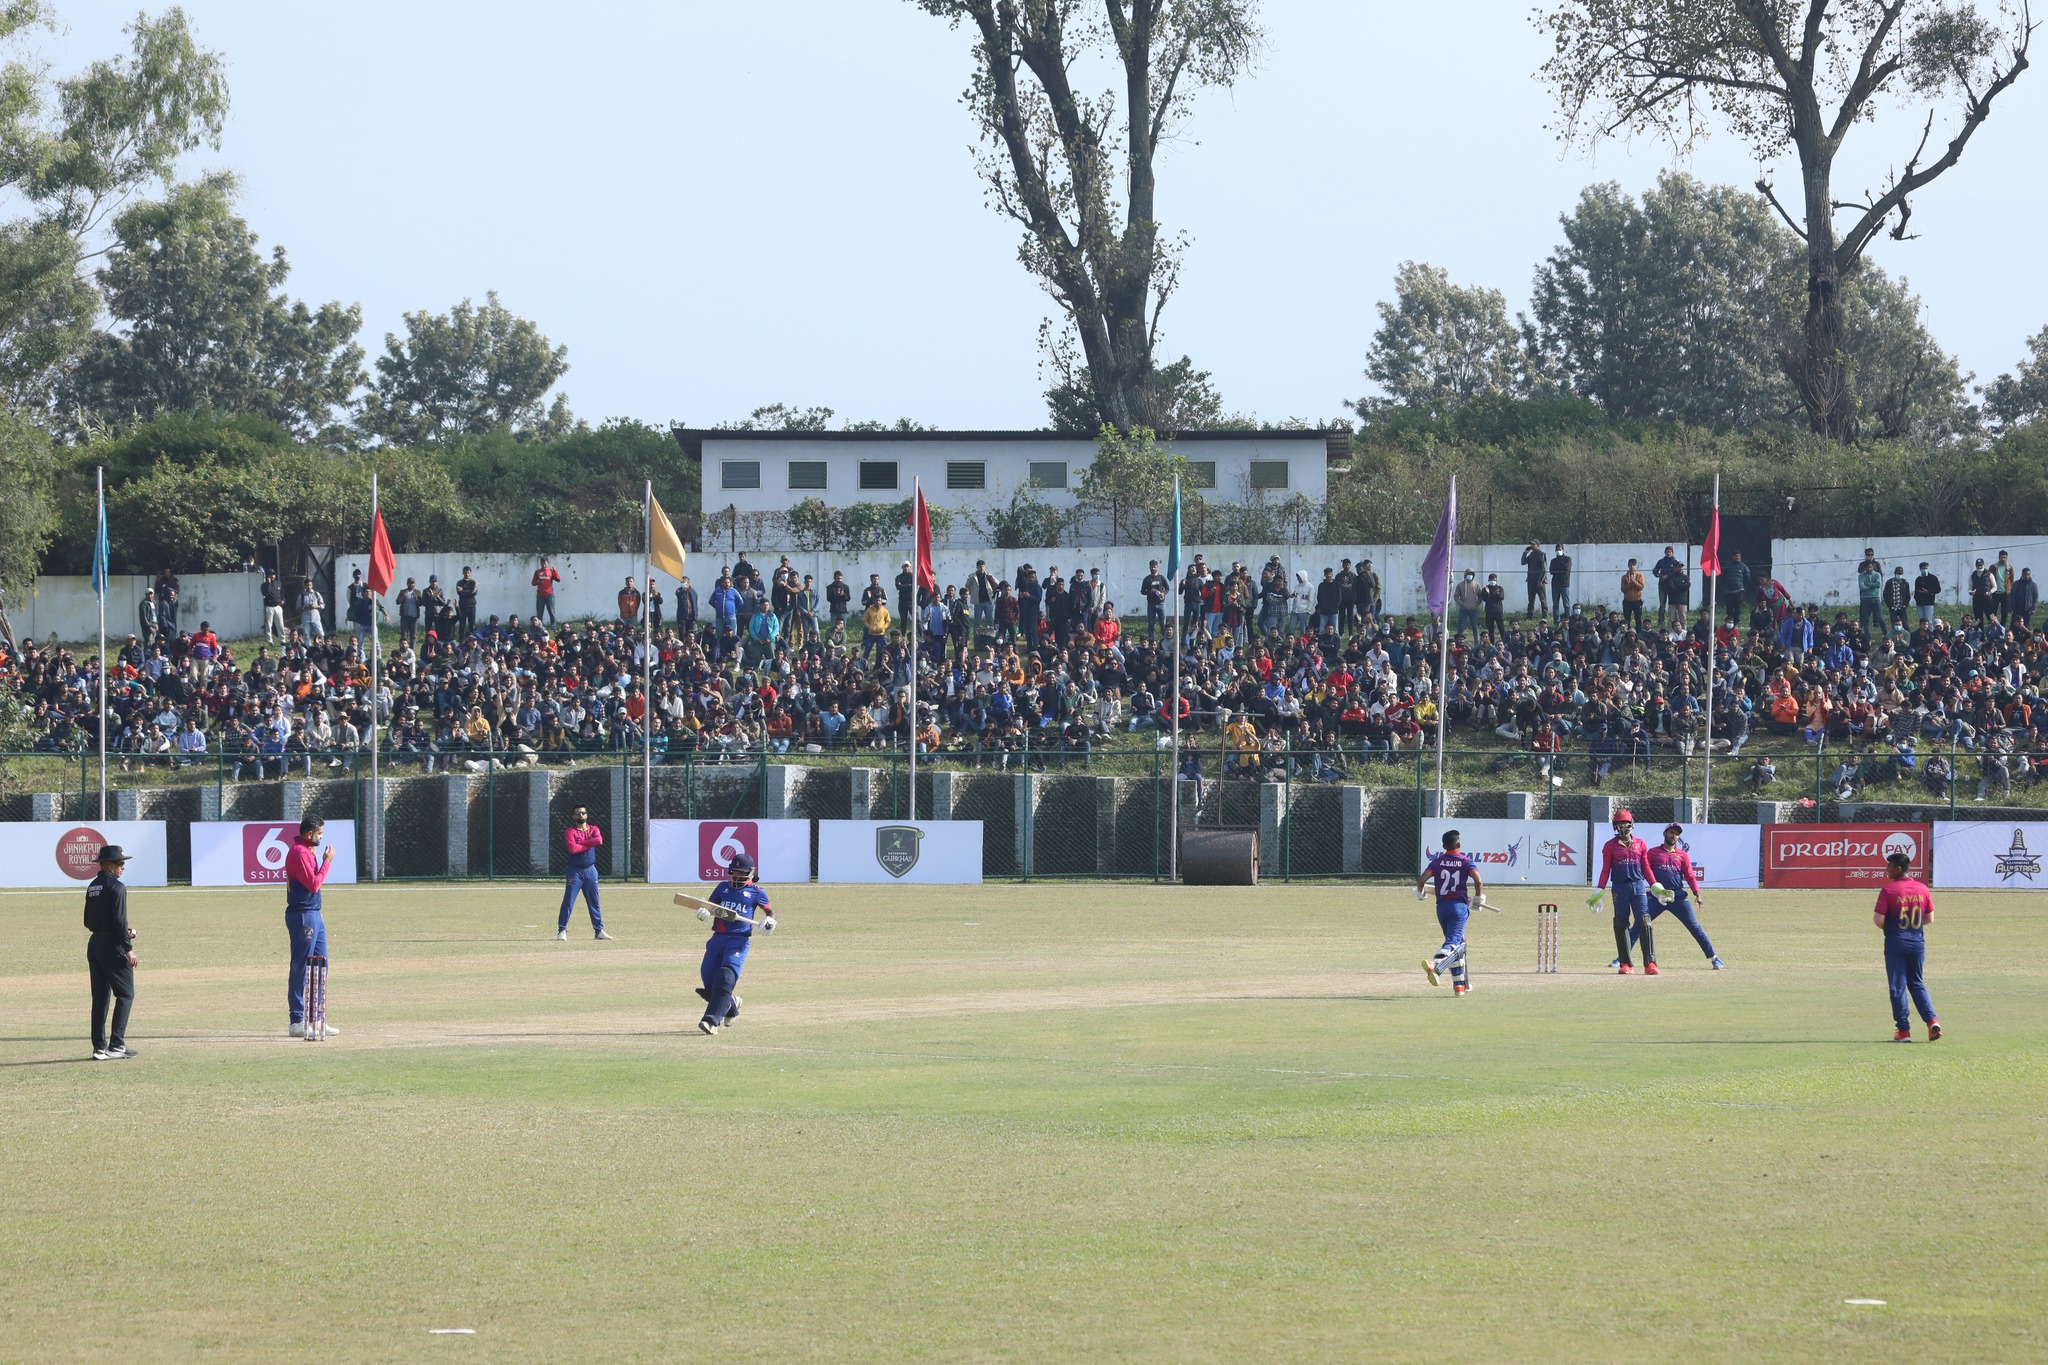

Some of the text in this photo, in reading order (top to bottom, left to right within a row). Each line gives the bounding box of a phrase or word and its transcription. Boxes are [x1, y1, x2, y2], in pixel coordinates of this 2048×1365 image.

[63, 843, 102, 854] JANAKPUR
[256, 827, 290, 870] 6
[711, 826, 746, 869] 6
[1885, 844, 1913, 854] PAY
[882, 855, 913, 863] GURKHAS
[250, 870, 288, 879] SSIXE
[1440, 869, 1461, 896] 21
[1898, 905, 1923, 930] 50
